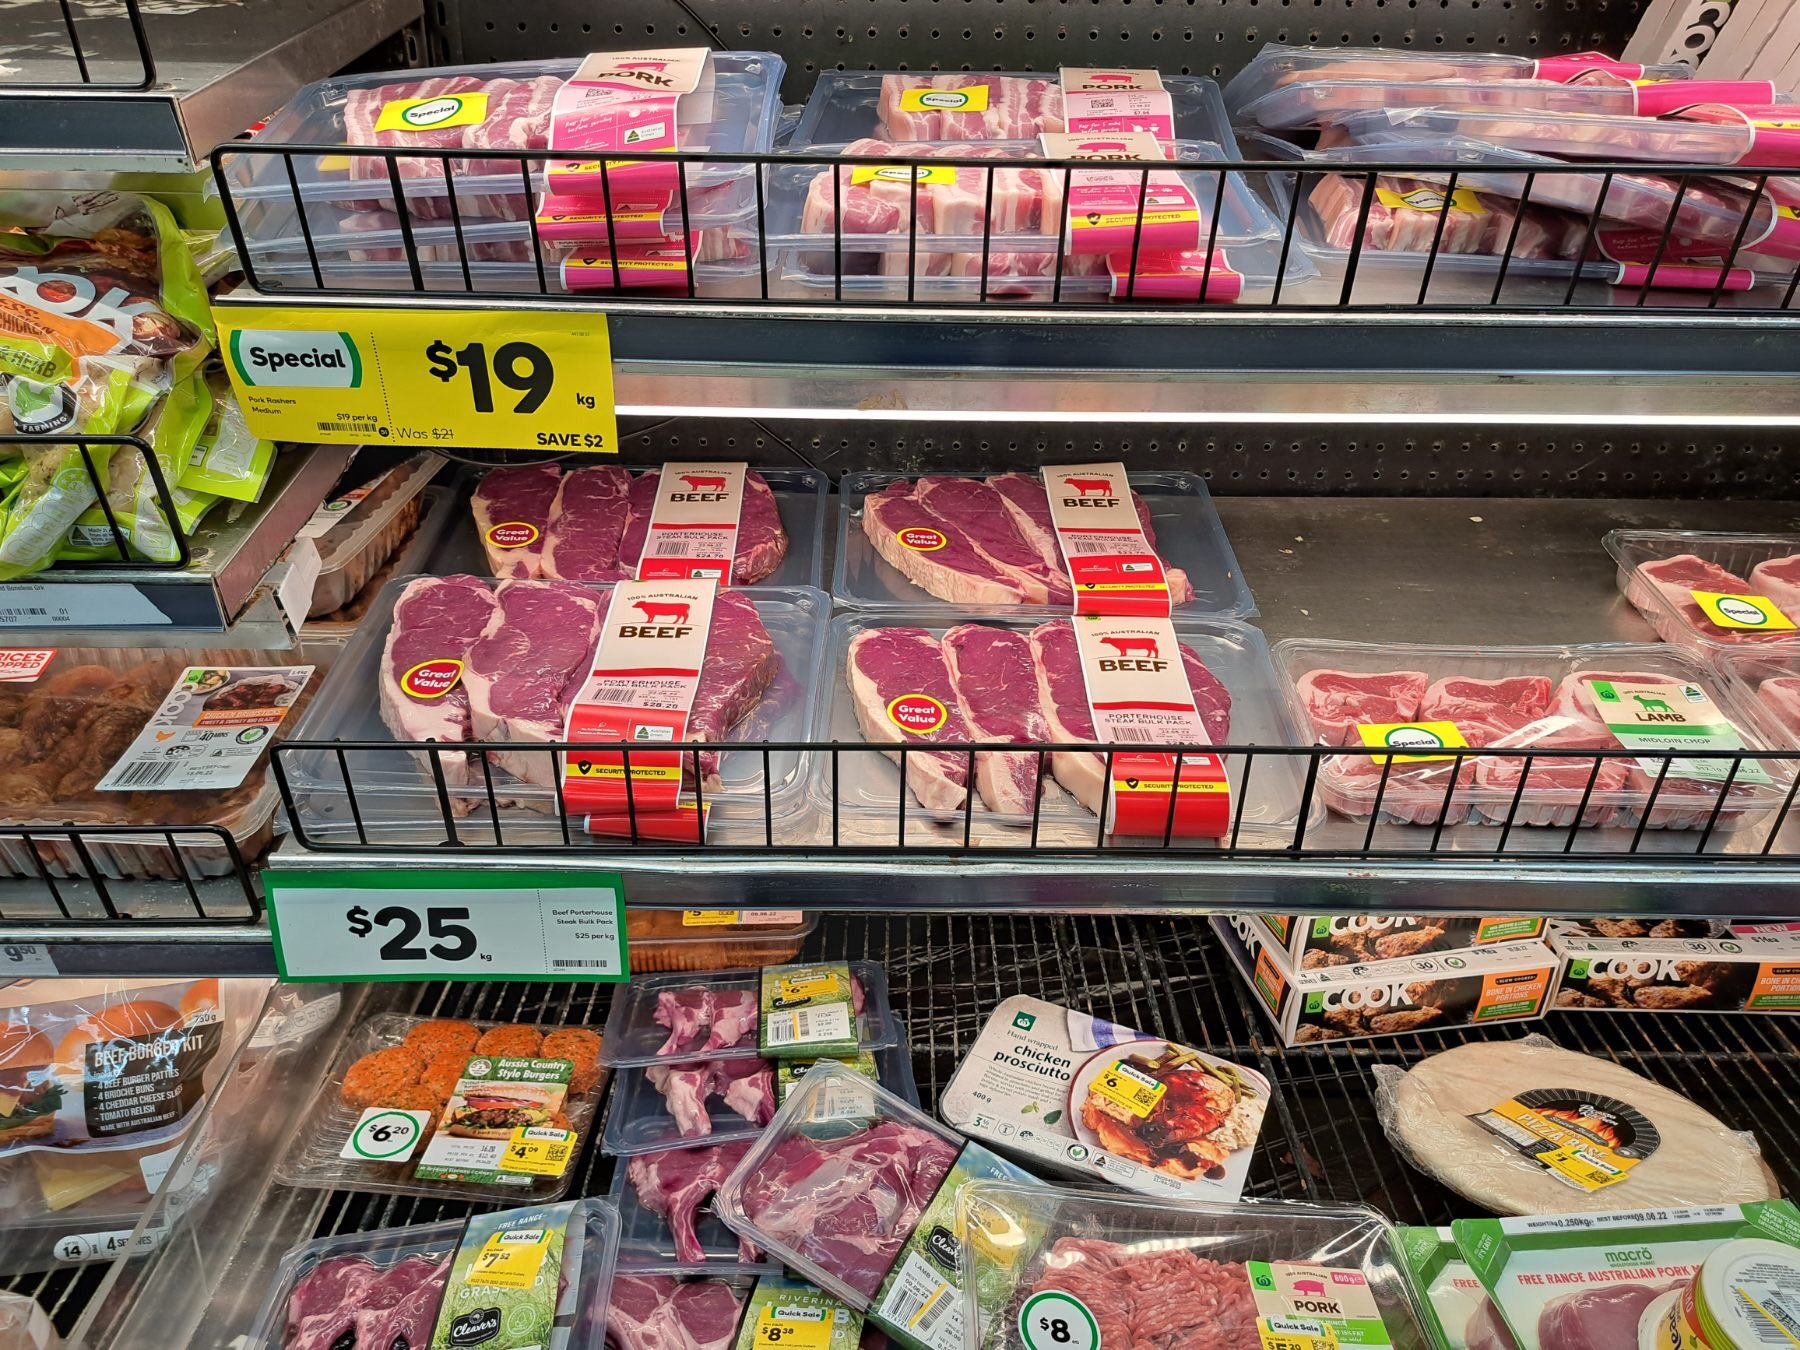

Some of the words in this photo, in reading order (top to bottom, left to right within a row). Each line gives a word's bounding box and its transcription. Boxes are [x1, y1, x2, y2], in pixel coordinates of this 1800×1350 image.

[598, 71, 674, 87] PORK
[409, 105, 455, 118] Special
[250, 347, 346, 372] Special
[426, 340, 554, 414] $19
[248, 396, 265, 404] Pork
[576, 393, 595, 408] kg
[22, 412, 70, 432] FARMING
[336, 413, 350, 421] $19
[367, 414, 378, 422] kg
[396, 428, 428, 439] Was
[432, 428, 454, 440] $21
[537, 433, 581, 446] SAVE
[584, 434, 604, 448] $2
[670, 493, 729, 502] BEEF
[1063, 499, 1120, 507] BEEF
[495, 534, 530, 542] Value
[906, 538, 939, 546] Value
[627, 593, 647, 601] 100%
[648, 592, 699, 600] AUSTRALIAN
[1723, 606, 1760, 617] Special
[618, 625, 693, 639] BEEF
[1099, 659, 1168, 672] BEEF
[419, 669, 457, 678] Great
[414, 678, 450, 688] Value
[898, 705, 936, 714] Great
[899, 713, 937, 723] Value
[1635, 713, 1686, 723] LAMB
[199, 733, 213, 741] 40
[1392, 737, 1436, 747] Special
[346, 905, 478, 962] $25
[1753, 924, 1788, 933] NEW
[575, 932, 590, 940] $25
[591, 933, 604, 941] per
[605, 933, 615, 941] kg
[480, 953, 492, 962] kg
[1416, 961, 1433, 970] 30
[1587, 959, 1681, 981] COOK
[1486, 988, 1505, 997] BONE
[1513, 983, 1542, 993] CHICKEN
[1323, 983, 1413, 1012] COOK
[1496, 993, 1529, 1002] PORTIONS
[1007, 1030, 1027, 1041] Hand
[1028, 1038, 1058, 1051] wrapped
[94, 1048, 126, 1067] BEEF
[128, 1040, 178, 1061] BURGER
[183, 1034, 204, 1052] KIT
[1014, 1046, 1070, 1068] chicken
[498, 1060, 529, 1068] Aussie
[531, 1060, 567, 1071] Country
[993, 1052, 1070, 1081] prosciutto
[105, 1079, 121, 1088] BEEF
[122, 1074, 150, 1086] BURGER
[151, 1068, 180, 1081] PATTIES
[497, 1069, 521, 1079] Style
[523, 1070, 560, 1081] Burgers
[1104, 1073, 1118, 1087] $6
[1122, 1067, 1140, 1079] Quick
[1141, 1076, 1154, 1087] Sale
[105, 1087, 134, 1100] BRIOCHE
[136, 1084, 155, 1094] BUNS
[973, 1091, 986, 1100] 400
[105, 1097, 138, 1110] CHEDDAR
[140, 1092, 166, 1105] CHEESE
[100, 1110, 129, 1121] TOMATO
[131, 1105, 155, 1116] RELISH
[100, 1124, 116, 1132] MADE
[131, 1117, 162, 1127] AUSTRALIAN
[163, 1112, 175, 1120] BEEF
[973, 1117, 981, 1127] 3
[528, 1130, 547, 1138] Quick
[1516, 1113, 1565, 1142] PIZZA
[1564, 1137, 1609, 1160] BASE
[1580, 1153, 1600, 1167] Quick
[498, 1220, 518, 1230] FREE
[519, 1214, 544, 1226] RANGE
[1558, 1218, 1589, 1228] 0.250kg
[1635, 1212, 1668, 1222] 09.06.22
[504, 1232, 523, 1241] Quick
[524, 1231, 540, 1240] Sale
[107, 1237, 117, 1251] 4
[62, 1246, 82, 1258] 14
[914, 1262, 931, 1279] LAMB
[1297, 1271, 1327, 1279] AUSTRALIAN
[1518, 1274, 1545, 1286] FREE
[1547, 1271, 1585, 1285] RANGE
[1588, 1266, 1655, 1282] AUSTRALIAN
[1657, 1265, 1689, 1278] PORK
[1453, 1279, 1480, 1288] FREE
[779, 1295, 842, 1306] RIVERINA
[1293, 1300, 1341, 1313] PORK
[454, 1318, 497, 1338] Cleaver's
[1040, 1317, 1071, 1343] $8
[1274, 1322, 1299, 1330] Quick
[1300, 1323, 1319, 1331] Sale
